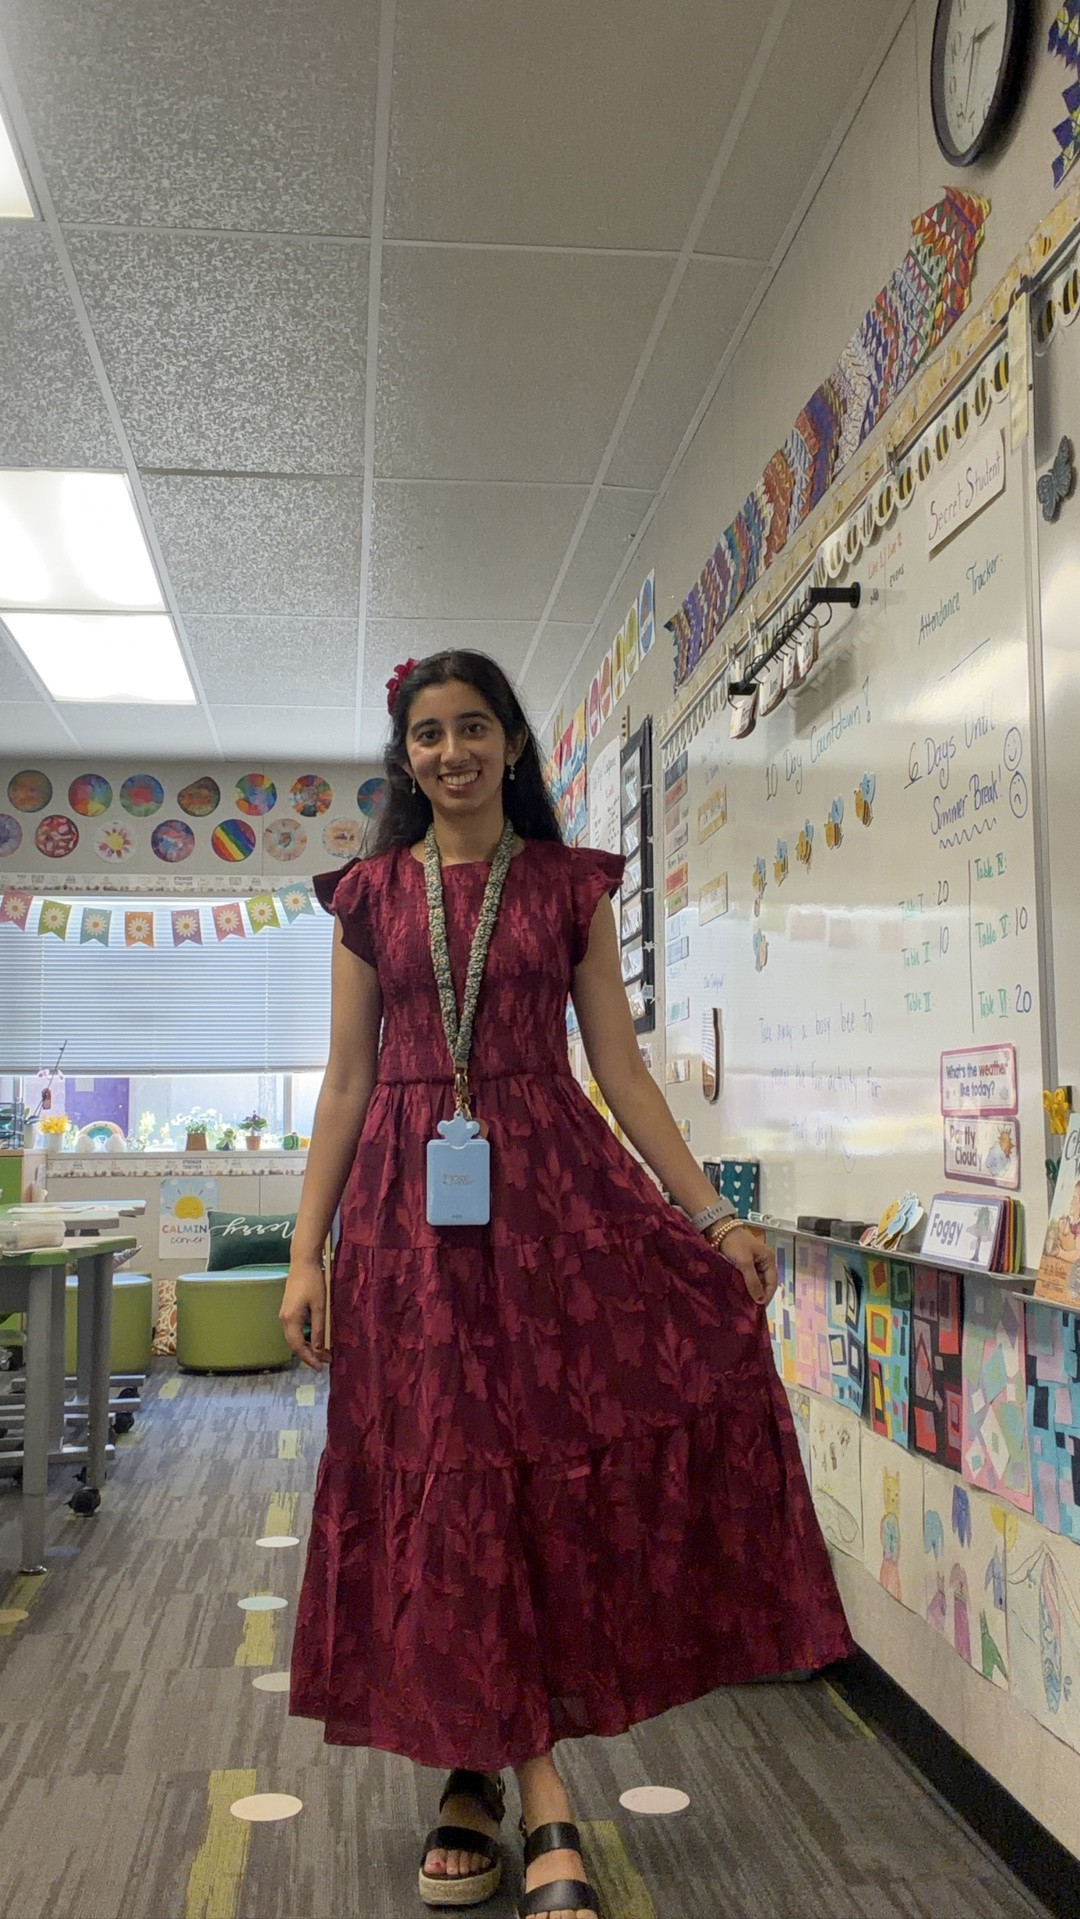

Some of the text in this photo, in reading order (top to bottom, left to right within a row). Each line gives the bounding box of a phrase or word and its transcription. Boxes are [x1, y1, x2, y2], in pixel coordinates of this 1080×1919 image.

[928, 450, 1001, 541] Secret Student
[918, 553, 1003, 646] Attendance Tracker:
[908, 703, 995, 790] 6 Days Until
[765, 763, 779, 801] 10
[783, 749, 803, 794] Day
[931, 764, 1003, 835] Summer Break!
[974, 857, 993, 881] Table
[937, 880, 949, 906] 20
[974, 922, 997, 949] Table
[1015, 906, 1028, 937] 10
[901, 947, 920, 968] Table
[938, 926, 949, 958] 10
[904, 992, 921, 1014] Table
[978, 991, 995, 1019] Table
[1015, 984, 1032, 1014] 20
[815, 1009, 831, 1042] busy
[840, 1001, 854, 1033] bee
[862, 998, 873, 1033] to
[866, 1066, 881, 1098] for
[945, 1060, 1008, 1080] What's the weather
[959, 1080, 996, 1100] like today?
[949, 1125, 976, 1149] Partly
[954, 1147, 983, 1172] Cloudy
[162, 1224, 208, 1234] CALMIN
[170, 1236, 205, 1244] corner
[930, 1213, 964, 1247] Foggy
